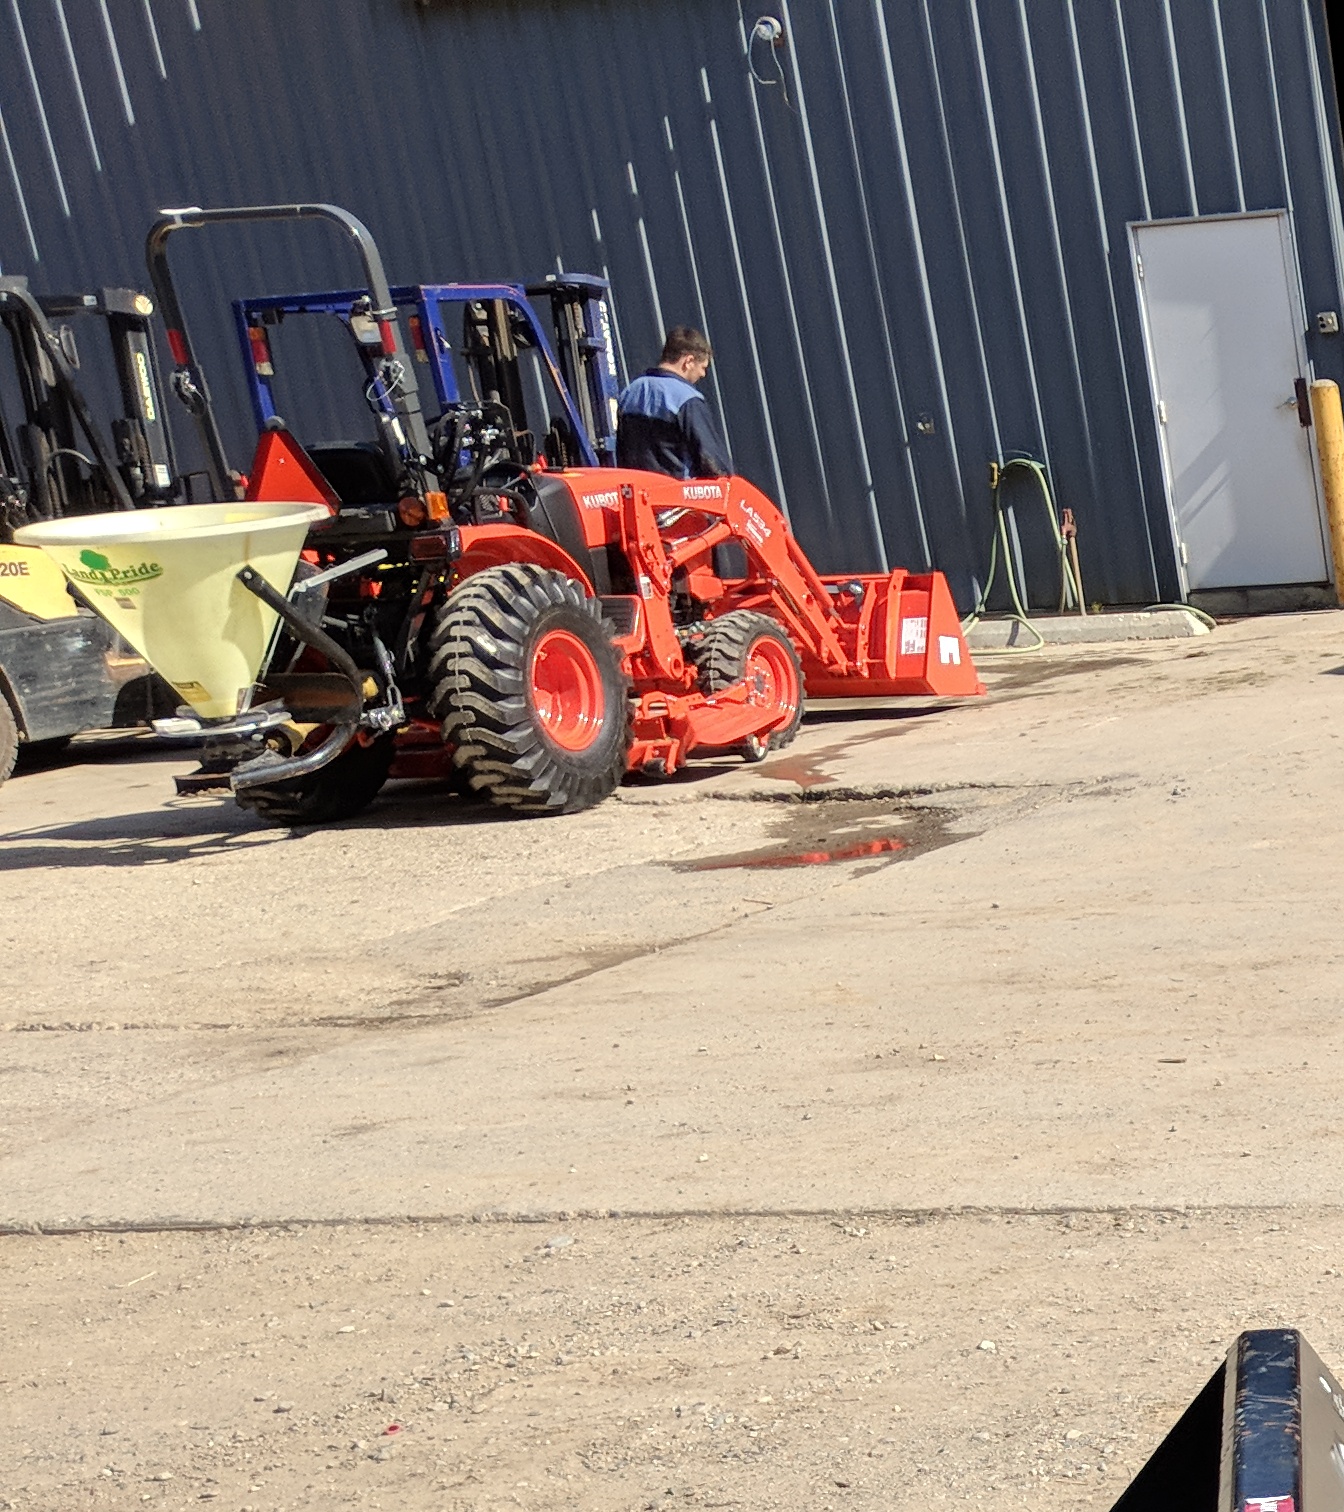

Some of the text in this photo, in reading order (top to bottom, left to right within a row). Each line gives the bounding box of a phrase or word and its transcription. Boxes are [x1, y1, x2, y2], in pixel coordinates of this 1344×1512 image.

[136, 352, 155, 420] DAEWOO
[582, 491, 619, 509] KUBOT
[683, 485, 722, 500] KUBOTA
[109, 561, 162, 582] Pride
